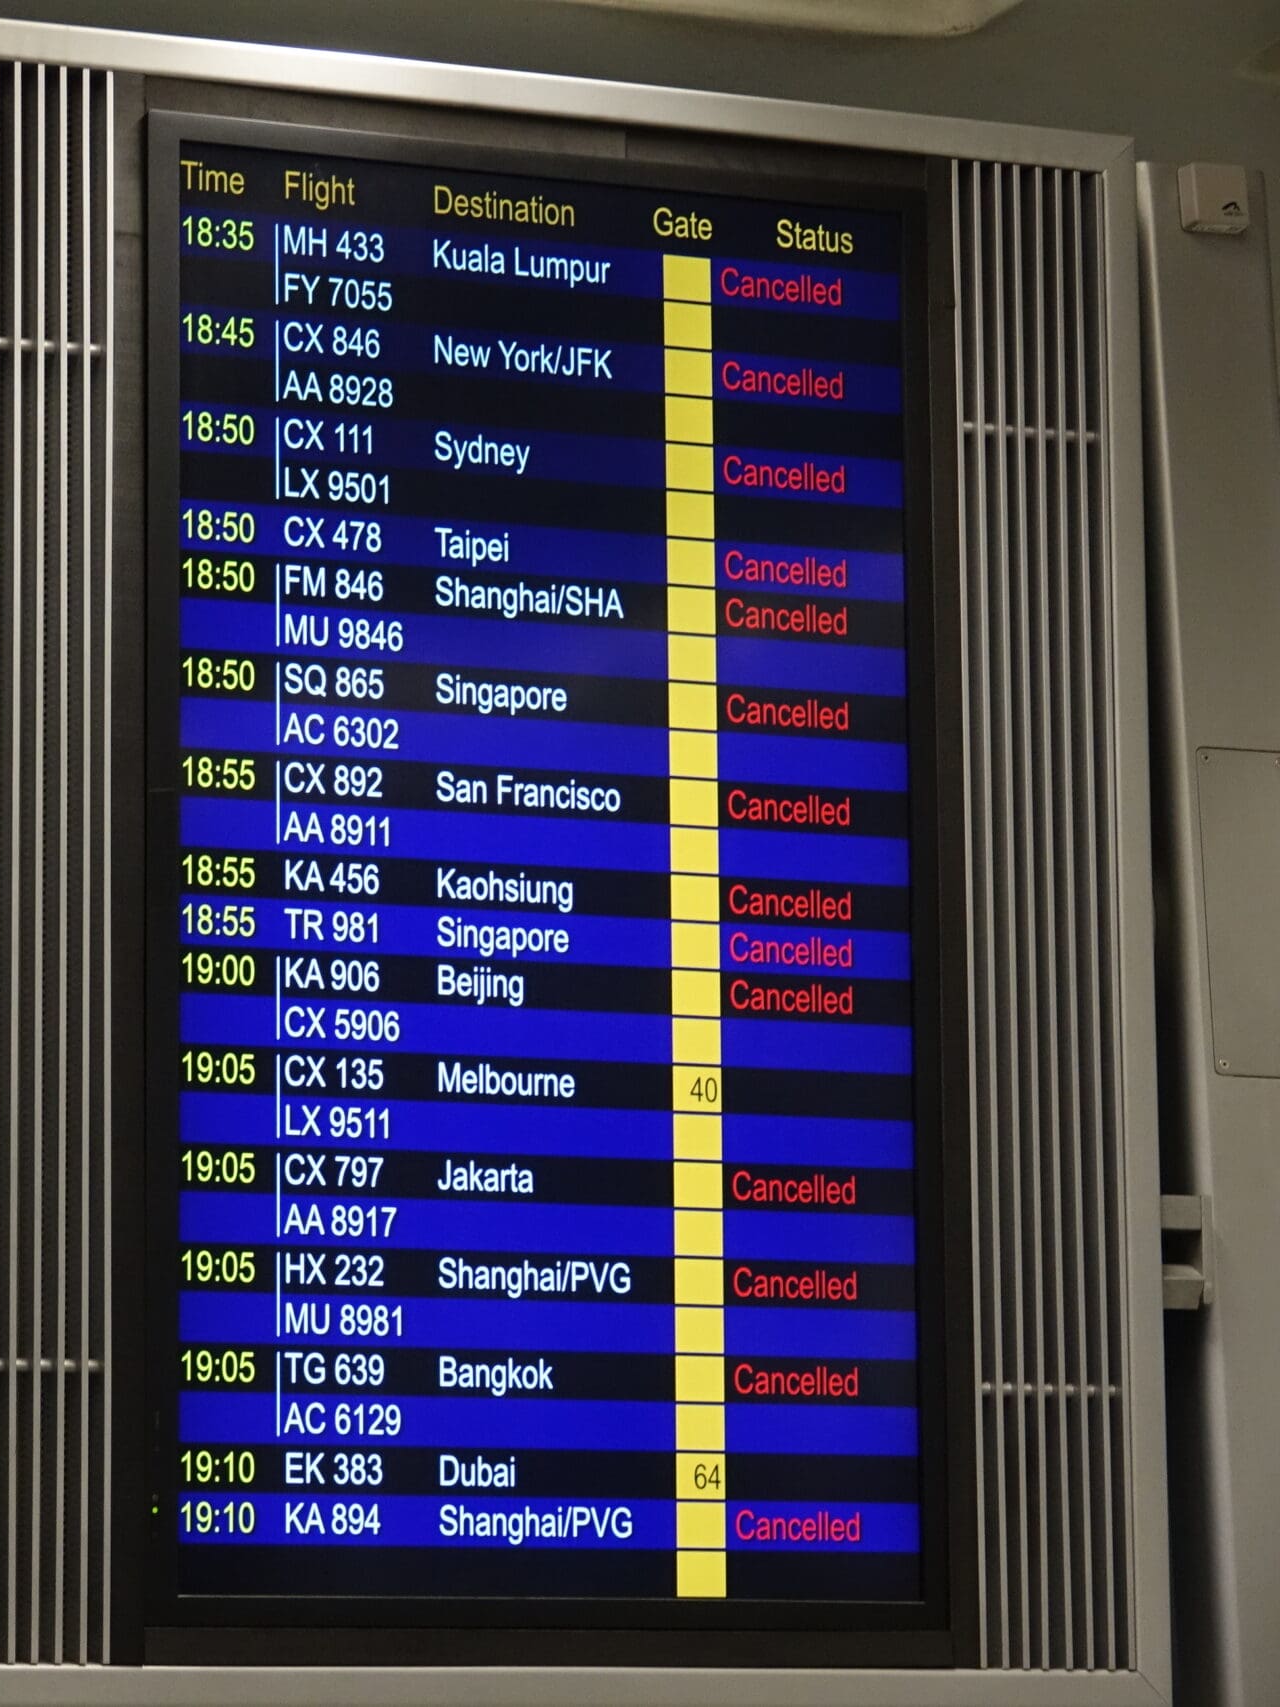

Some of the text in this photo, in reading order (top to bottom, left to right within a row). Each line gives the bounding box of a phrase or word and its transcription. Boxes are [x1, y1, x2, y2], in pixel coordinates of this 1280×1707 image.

[180, 159, 245, 195] Time
[284, 169, 356, 211] Flight
[434, 184, 575, 227] Destination
[653, 206, 713, 241] Gate
[776, 218, 854, 254] Status
[433, 238, 611, 289] Kuala Lumpur
[284, 272, 393, 312] FY 7055
[182, 312, 255, 348] 18:45
[433, 334, 613, 380] New York/JFK
[722, 361, 843, 399] Cancelled
[283, 417, 373, 455] CX 111
[434, 430, 531, 475] Sydney
[182, 508, 255, 544] 18:50
[283, 515, 382, 553] CX 478
[433, 526, 509, 568] Taipei
[182, 557, 256, 593] 18:50
[724, 550, 847, 588] Cancelled
[434, 575, 625, 619] Shanghai/SHA
[284, 613, 404, 653] MU 9846
[435, 672, 568, 716] Singapore
[726, 693, 849, 731] Cancelled
[282, 711, 400, 750] AC 6302
[182, 755, 256, 791] 18:55
[435, 770, 621, 813] San Francisco
[283, 810, 390, 848] AA 8911
[436, 867, 574, 914] Kaohsiung
[728, 884, 852, 921] Cancelled
[181, 902, 256, 938] 18:55
[436, 915, 570, 959] Singapore
[284, 956, 381, 993] KA 906
[437, 963, 525, 1008] Beijing
[729, 979, 853, 1015] Cancelled
[181, 1050, 256, 1085] 19:05
[284, 1054, 384, 1091] CX 135
[437, 1060, 576, 1099] Melbourne
[690, 1077, 718, 1103] 40
[181, 1149, 256, 1184] 19:05
[284, 1152, 385, 1188] CX 797
[437, 1158, 534, 1194] Jakarta
[437, 1256, 632, 1299] Shanghai/PVG
[733, 1266, 857, 1301] Cancelled
[284, 1301, 403, 1337] MU 8981
[180, 1349, 256, 1384] 19:05
[439, 1355, 554, 1397] Bangkok
[283, 1401, 402, 1437] AC 6129
[439, 1454, 516, 1488] Dubai
[694, 1463, 721, 1490] 64
[180, 1500, 255, 1534] 19:10
[284, 1501, 382, 1536] KA 894
[438, 1503, 633, 1546] Shanghai/PVG
[735, 1509, 861, 1542] Cancelled
